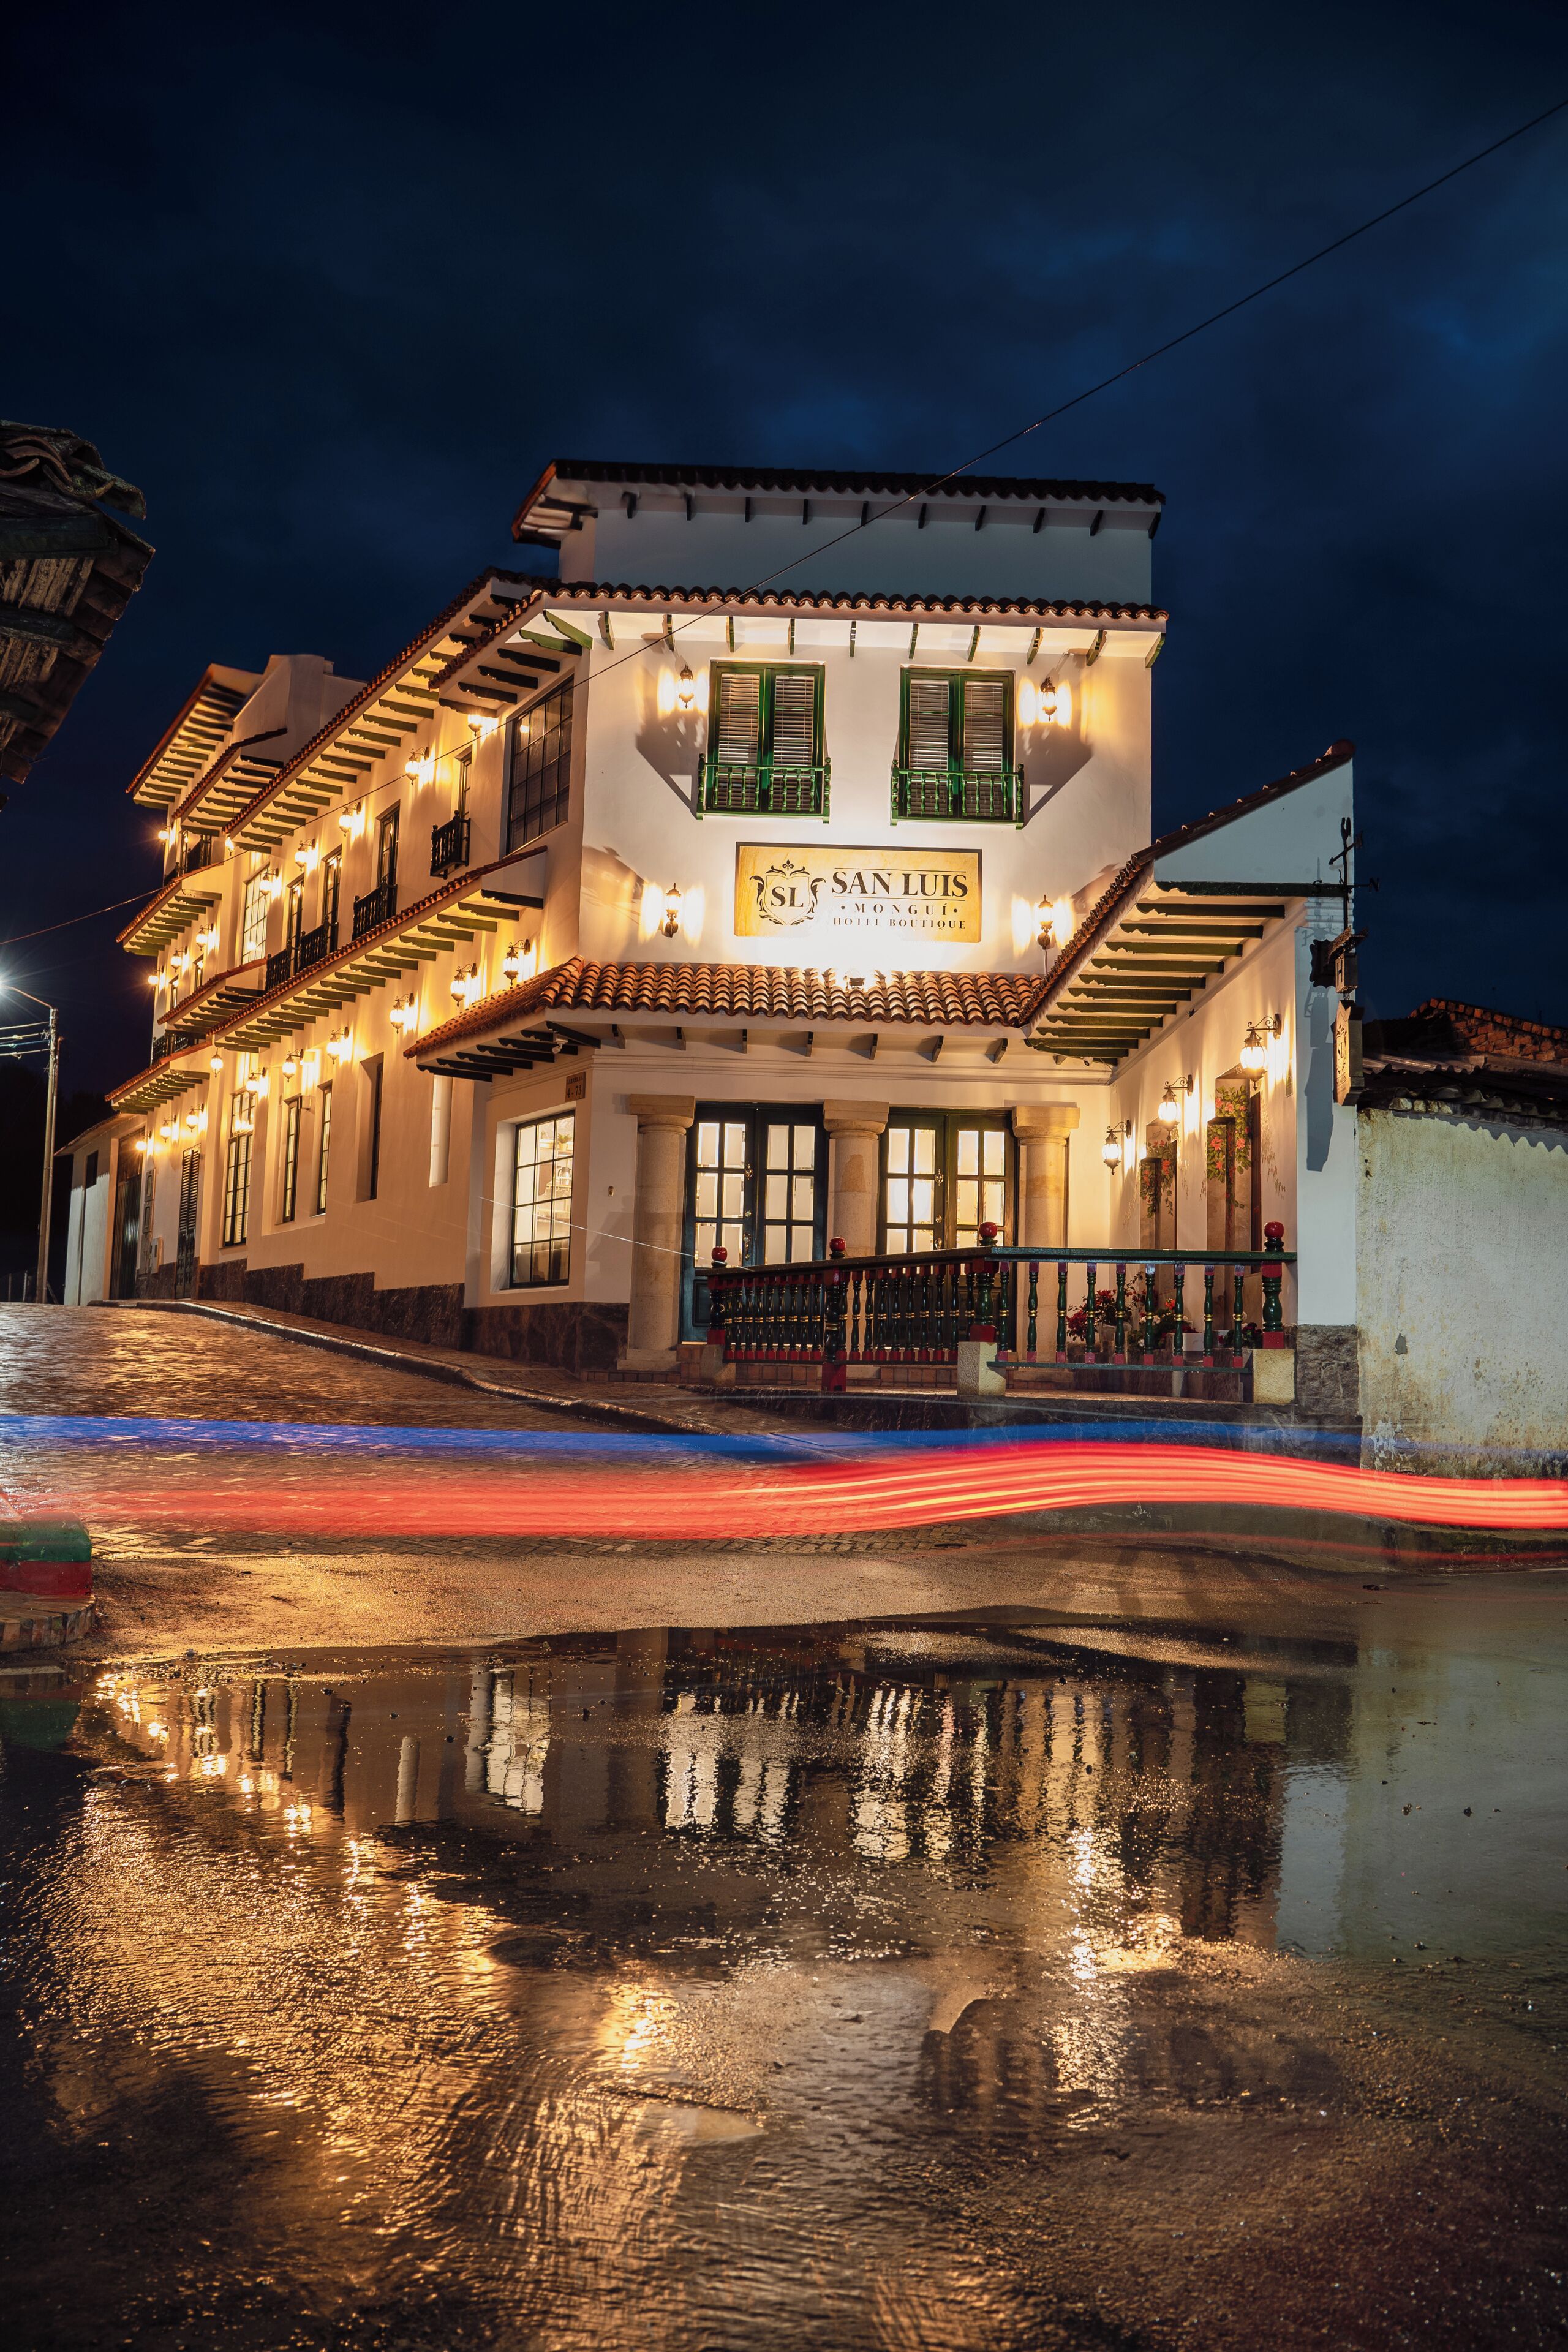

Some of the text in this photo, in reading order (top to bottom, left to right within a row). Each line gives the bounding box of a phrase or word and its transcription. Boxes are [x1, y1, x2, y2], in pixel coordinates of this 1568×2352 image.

[832, 872, 968, 897] SAN LUIS
[771, 886, 804, 908] SL
[890, 919, 966, 930] BOUTIQUE
